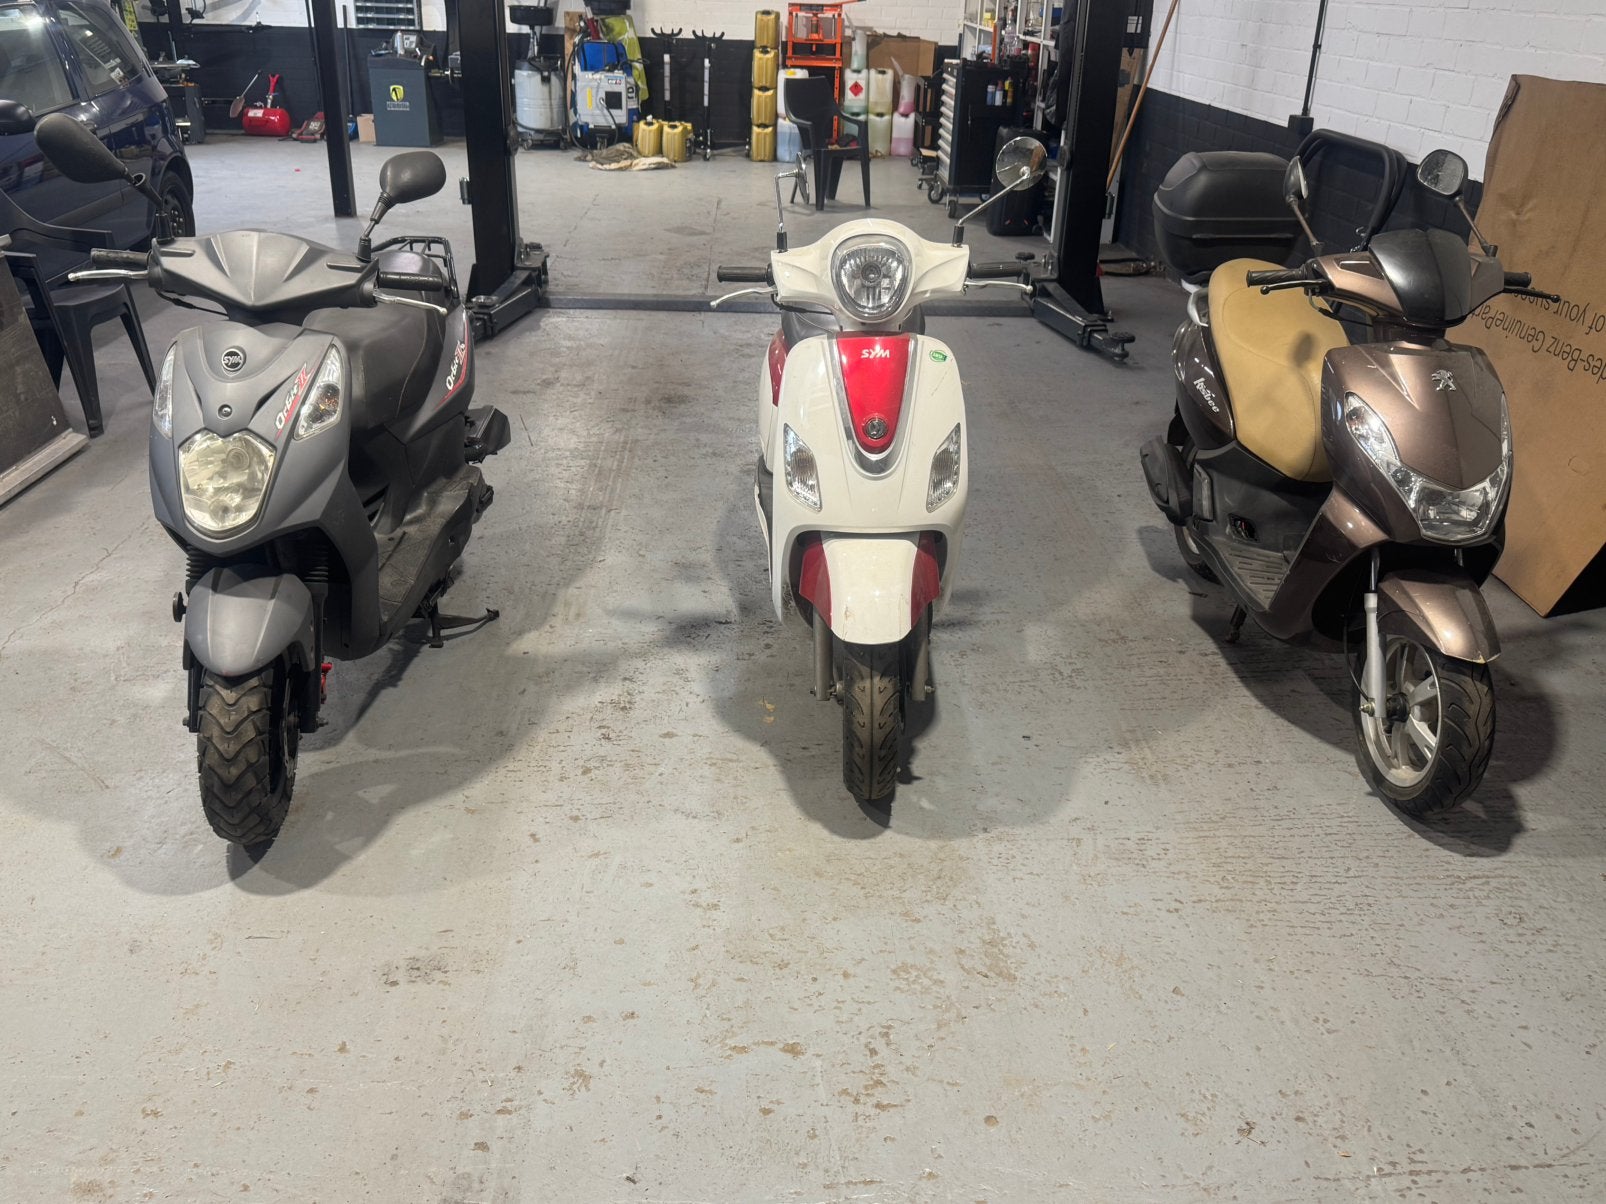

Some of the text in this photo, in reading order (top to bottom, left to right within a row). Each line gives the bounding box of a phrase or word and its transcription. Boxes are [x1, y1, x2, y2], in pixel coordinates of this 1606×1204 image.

[1553, 300, 1606, 335] of your
[223, 355, 242, 366] SYM
[861, 348, 890, 359] SYM
[275, 384, 299, 430] Orbit
